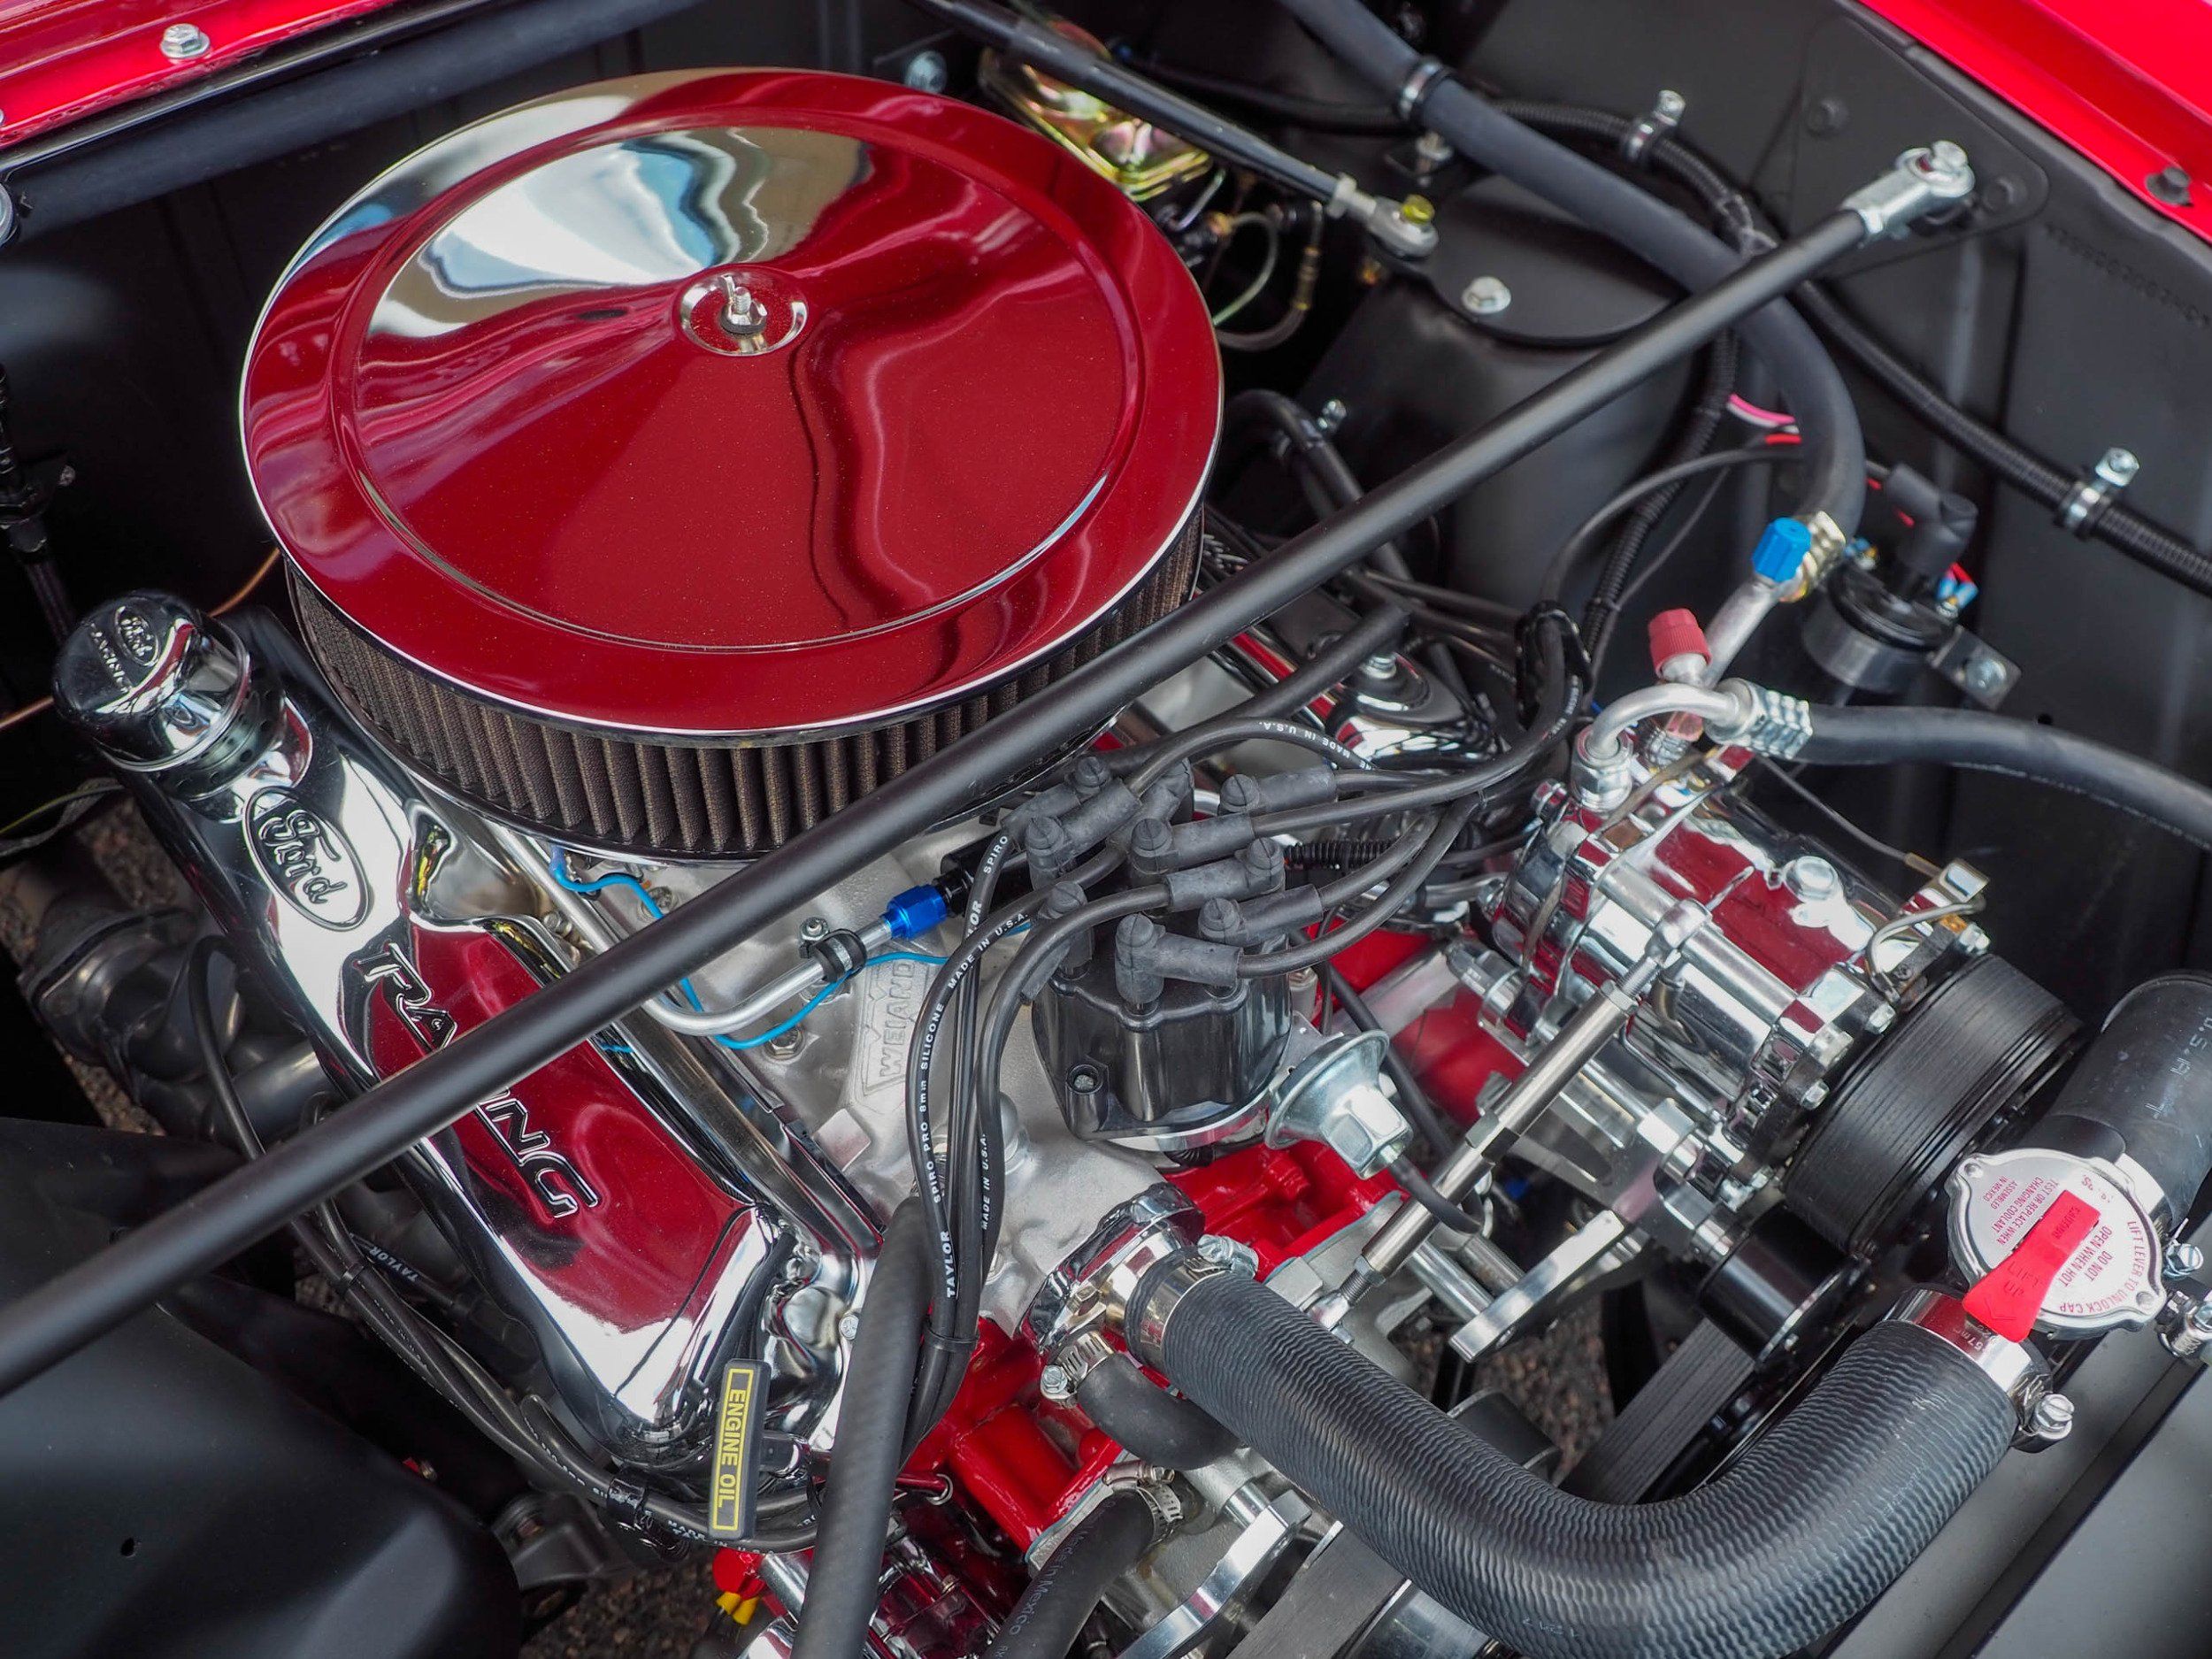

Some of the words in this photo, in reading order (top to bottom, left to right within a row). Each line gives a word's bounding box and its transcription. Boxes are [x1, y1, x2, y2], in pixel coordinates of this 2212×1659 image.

[1303, 729, 1320, 741] IN
[1321, 735, 1352, 758] MADE
[257, 809, 348, 904] Ford
[983, 836, 1008, 874] SPIRO
[995, 913, 1028, 936] U.S.A.
[978, 938, 990, 951] IN
[948, 954, 975, 989] MADE
[879, 962, 915, 1079] WEIAND
[920, 1003, 944, 1071] SILICONE
[919, 1121, 931, 1152] PRO
[926, 1160, 941, 1203] SPIRO
[984, 1177, 991, 1190] IN
[1983, 1181, 2002, 1202] MEXICO
[2016, 1177, 2044, 1209] CHANGING
[2044, 1179, 2059, 1195] TEST
[1990, 1180, 2018, 1210] ASSEMBLED
[2036, 1194, 2045, 1204] OR
[980, 1191, 991, 1230] MADE
[1991, 1204, 2017, 1233] COOLANT
[2012, 1202, 2038, 1228] REPLACE
[1996, 1225, 2016, 1245] WHEN
[2090, 1225, 2112, 1248] OPEN
[2127, 1221, 2144, 1242] LIFT
[369, 1246, 420, 1280] TAYLOR
[939, 1230, 956, 1298] TAYLOR
[2071, 1247, 2096, 1271] WHEN
[2097, 1250, 2113, 1265] DO
[2131, 1245, 2145, 1277] LEVER
[2008, 1261, 2042, 1287] LIFT
[2058, 1268, 2076, 1286] HOT
[2084, 1262, 2103, 1281] NOT
[2004, 1280, 2024, 1297] UP
[2124, 1279, 2139, 1291] TO
[2060, 1302, 2084, 1314] CAP
[2085, 1289, 2128, 1312] UNLOCK
[721, 1389, 747, 1465] ENGINE
[718, 1473, 737, 1508] OIL
[1009, 1578, 1054, 1636] Mexico
